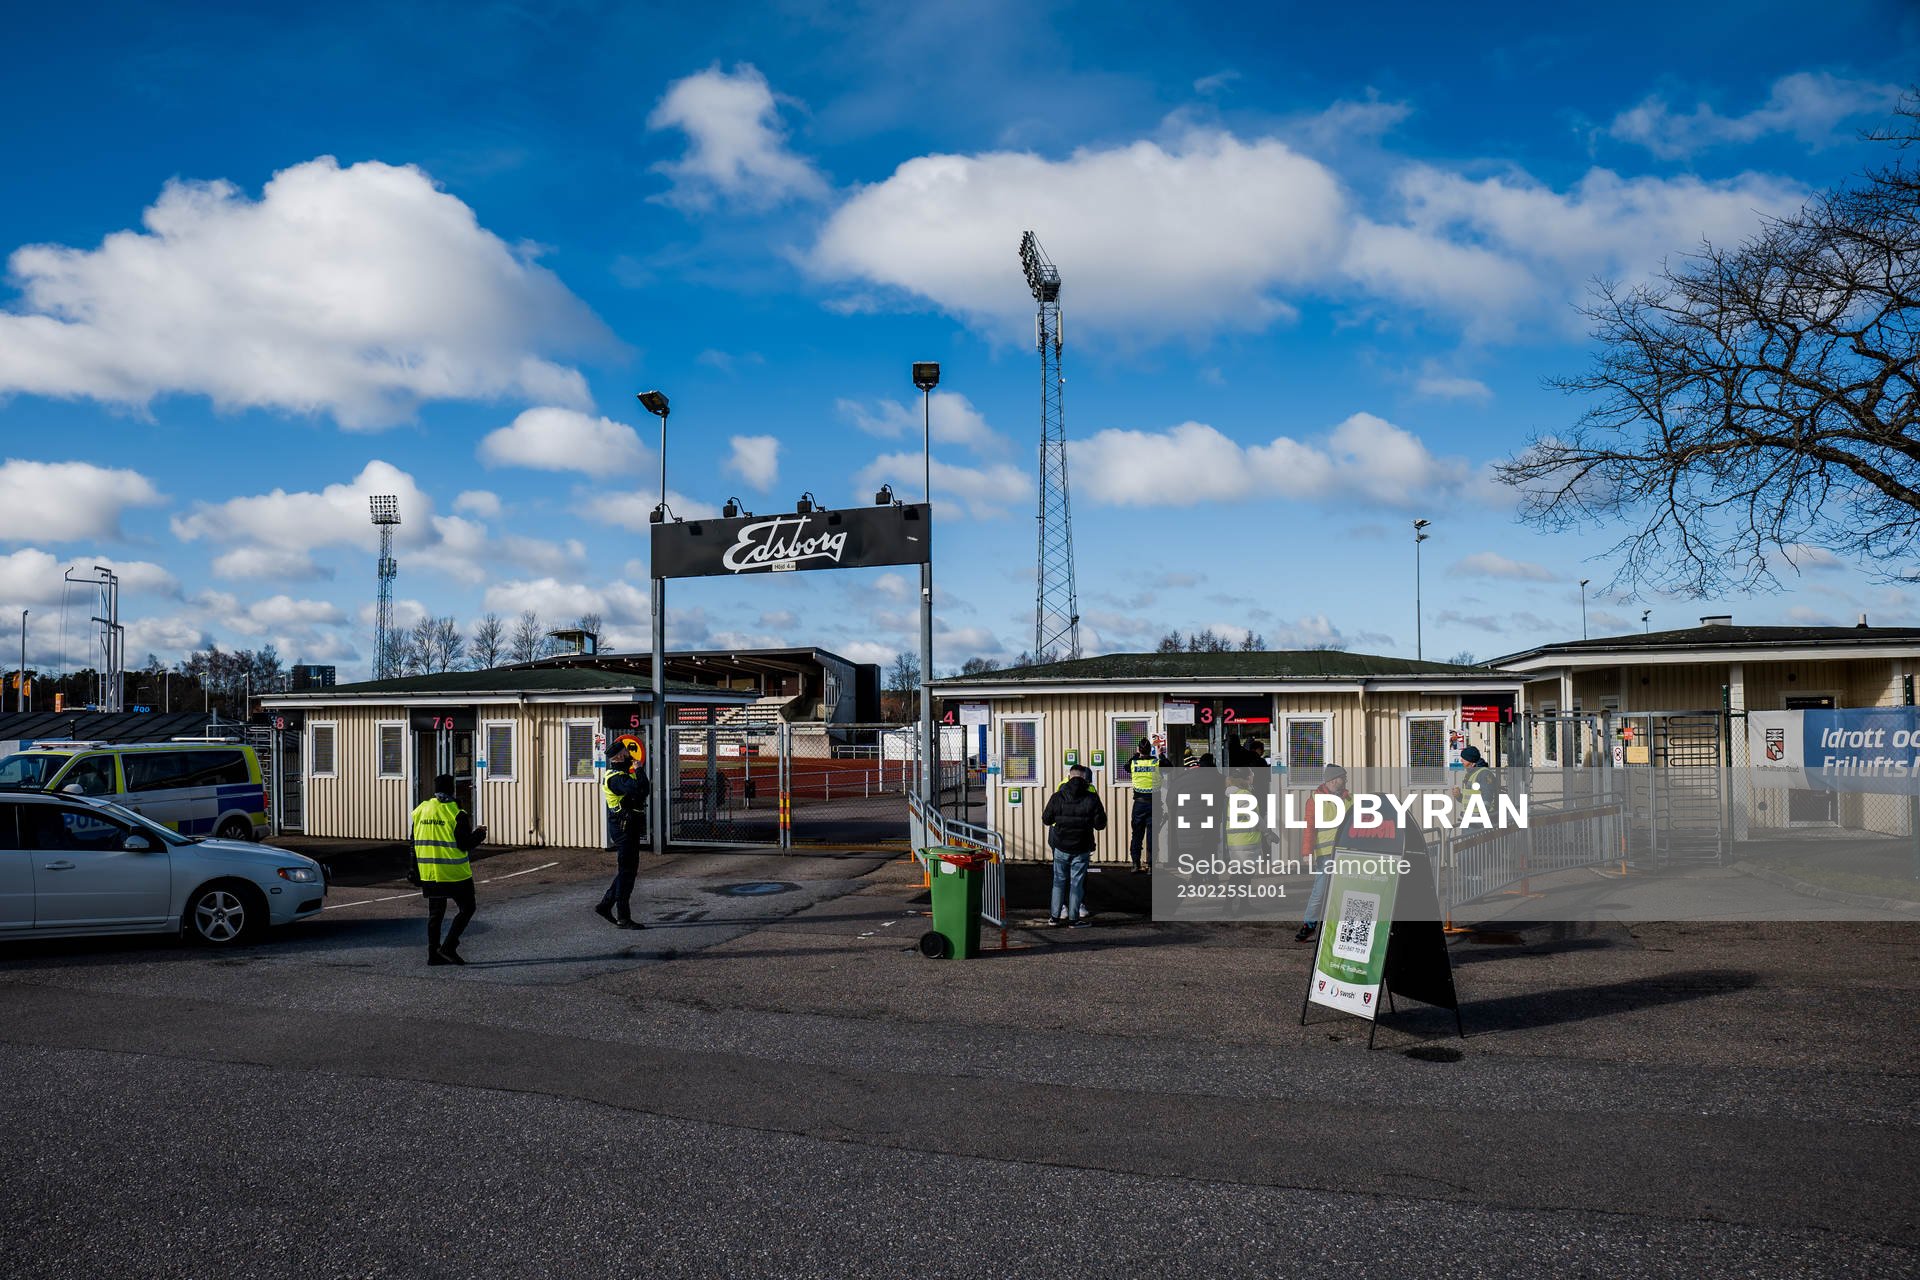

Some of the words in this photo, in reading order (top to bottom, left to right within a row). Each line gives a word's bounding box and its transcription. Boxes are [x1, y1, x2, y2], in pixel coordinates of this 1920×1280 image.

[723, 516, 848, 574] Edsborg
[630, 715, 639, 728] 5
[943, 710, 955, 725] 4
[1200, 708, 1213, 724] 3
[1224, 708, 1235, 724] 2
[1504, 707, 1513, 722] 1
[275, 717, 285, 729] 8
[433, 717, 439, 729] 7
[444, 717, 454, 730] 6
[1821, 728, 1886, 748] Idrott
[1822, 756, 1909, 778] Frilufts
